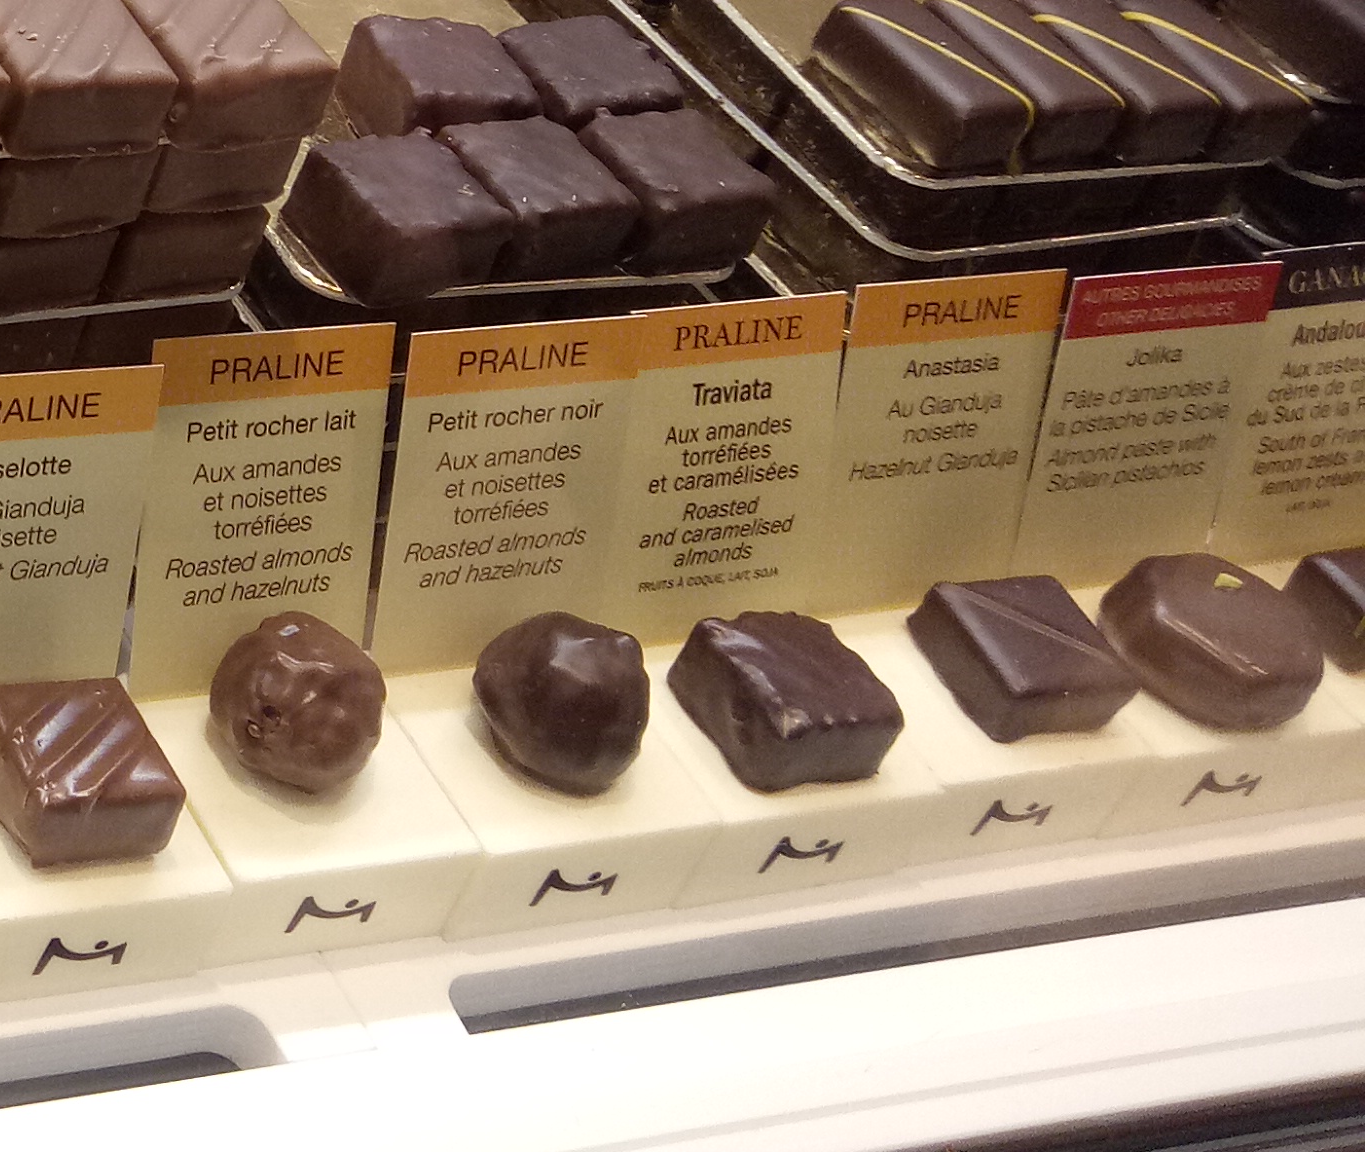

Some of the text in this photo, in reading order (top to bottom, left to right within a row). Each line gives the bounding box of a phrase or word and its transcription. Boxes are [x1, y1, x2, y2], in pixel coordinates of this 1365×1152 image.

[903, 295, 1022, 328] PRALINE
[673, 315, 804, 351] PRALINE
[210, 350, 345, 385] PRALINE
[458, 341, 589, 376] PRALINE
[903, 353, 1001, 379] Anastasia
[693, 377, 773, 407] Traviata
[887, 393, 1003, 420] Au Gianduja
[1062, 390, 1105, 410] Pâte
[1217, 377, 1231, 395] à
[187, 408, 357, 443] Petit rocher lait
[428, 398, 604, 433] Petit rocher noir
[665, 416, 793, 446] Aux amandes
[1050, 419, 1067, 436] la
[1070, 411, 1148, 436] pistache
[1153, 409, 1177, 425] de
[903, 421, 979, 444] noisette
[193, 453, 342, 485] Aux amandes
[436, 442, 582, 473] Aux amandes
[681, 443, 772, 468] torréfiées
[849, 448, 1019, 482] Hazelnut Gianduja
[445, 471, 566, 499] et noisettes
[648, 462, 800, 494] et caramélisées
[203, 483, 328, 513] et noisettes
[454, 499, 550, 526] torréfiées
[682, 497, 760, 522] Roasted
[214, 513, 313, 540] torréfiées
[638, 514, 795, 549] and caramelised
[166, 541, 353, 580] Roasted almonds
[403, 527, 587, 564] Roasted almonds
[673, 542, 753, 568] almonds
[10, 553, 110, 581] Gianduja
[419, 557, 564, 589] and hazelnuts
[183, 573, 331, 607] and hazelnuts
